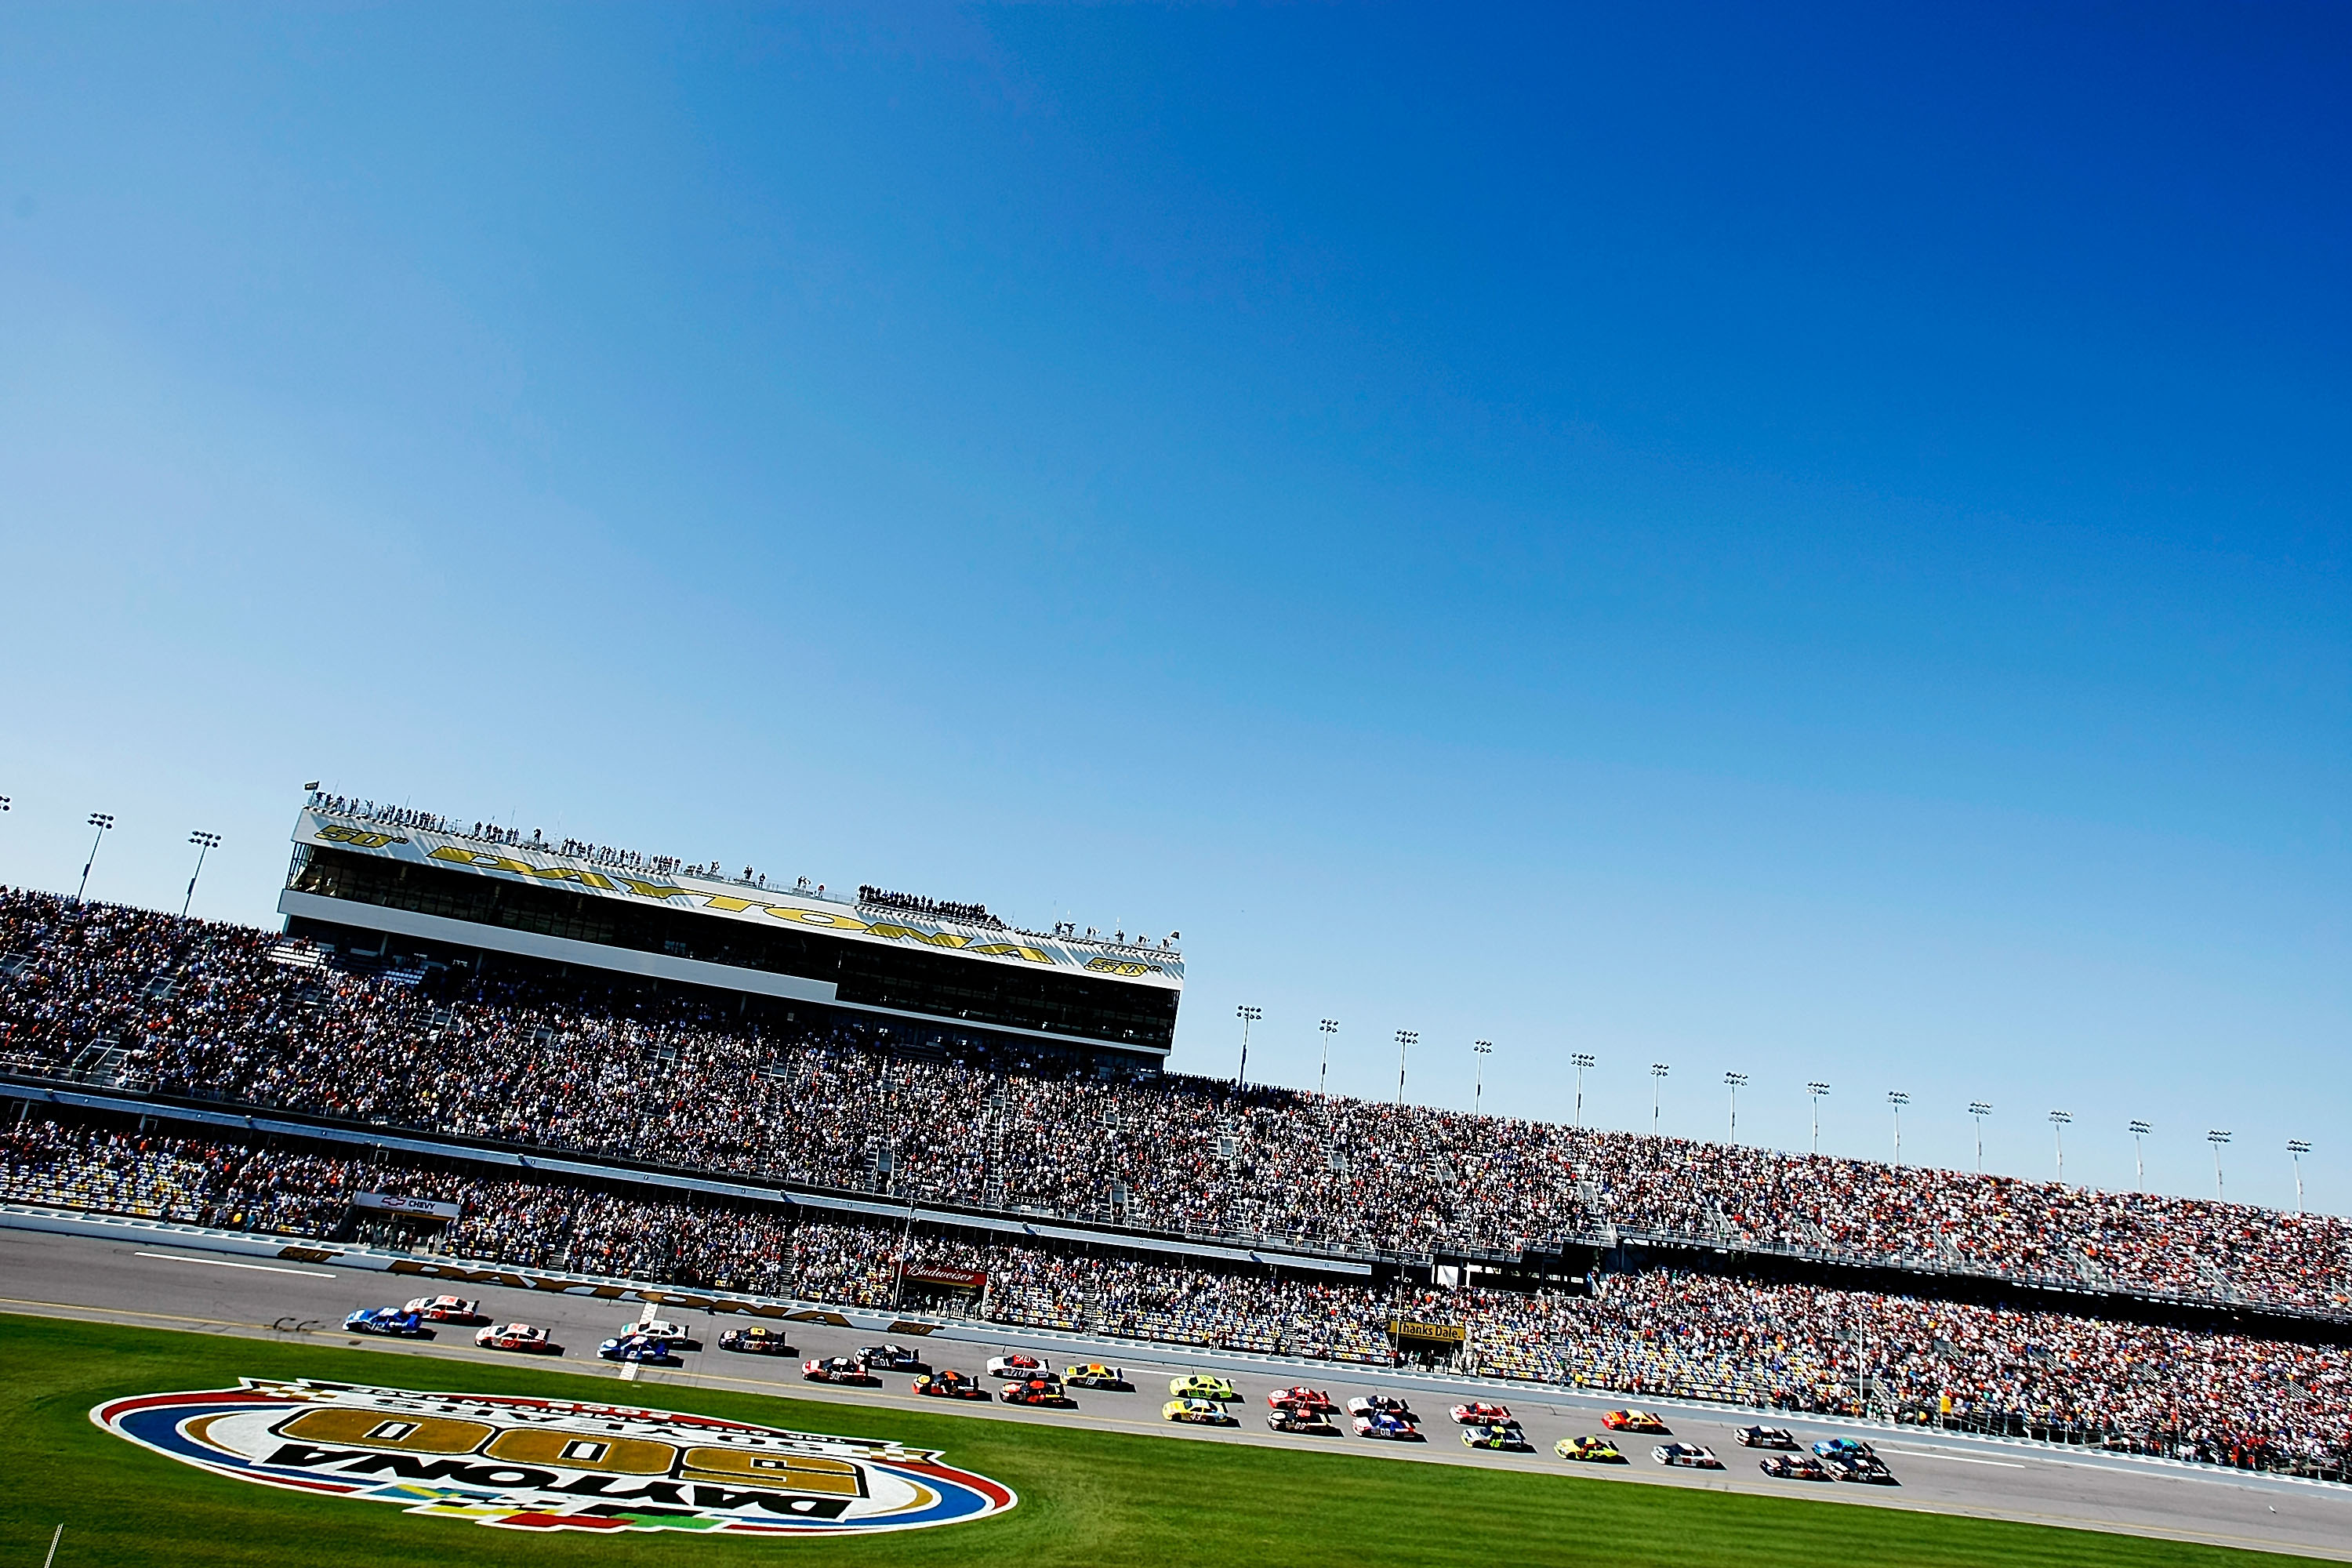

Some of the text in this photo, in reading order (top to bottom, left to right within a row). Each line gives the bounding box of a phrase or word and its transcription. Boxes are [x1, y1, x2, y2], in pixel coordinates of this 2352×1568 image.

[426, 845, 1056, 964] DAYTONA
[408, 1200, 436, 1210] CHEVY
[907, 1264, 975, 1281] Budweiser
[386, 1258, 854, 1328] DAYTONA
[1398, 1323, 1461, 1339] Thanks Dale.
[879, 1358, 891, 1367] 01
[1011, 1369, 1024, 1377] 70
[1015, 1355, 1031, 1363] 70
[347, 1387, 846, 1444] THE GREAT AMERICAN RACE
[368, 1398, 691, 1437] YEARS
[267, 1406, 870, 1499] 500
[263, 1443, 852, 1520] DAYTONA
